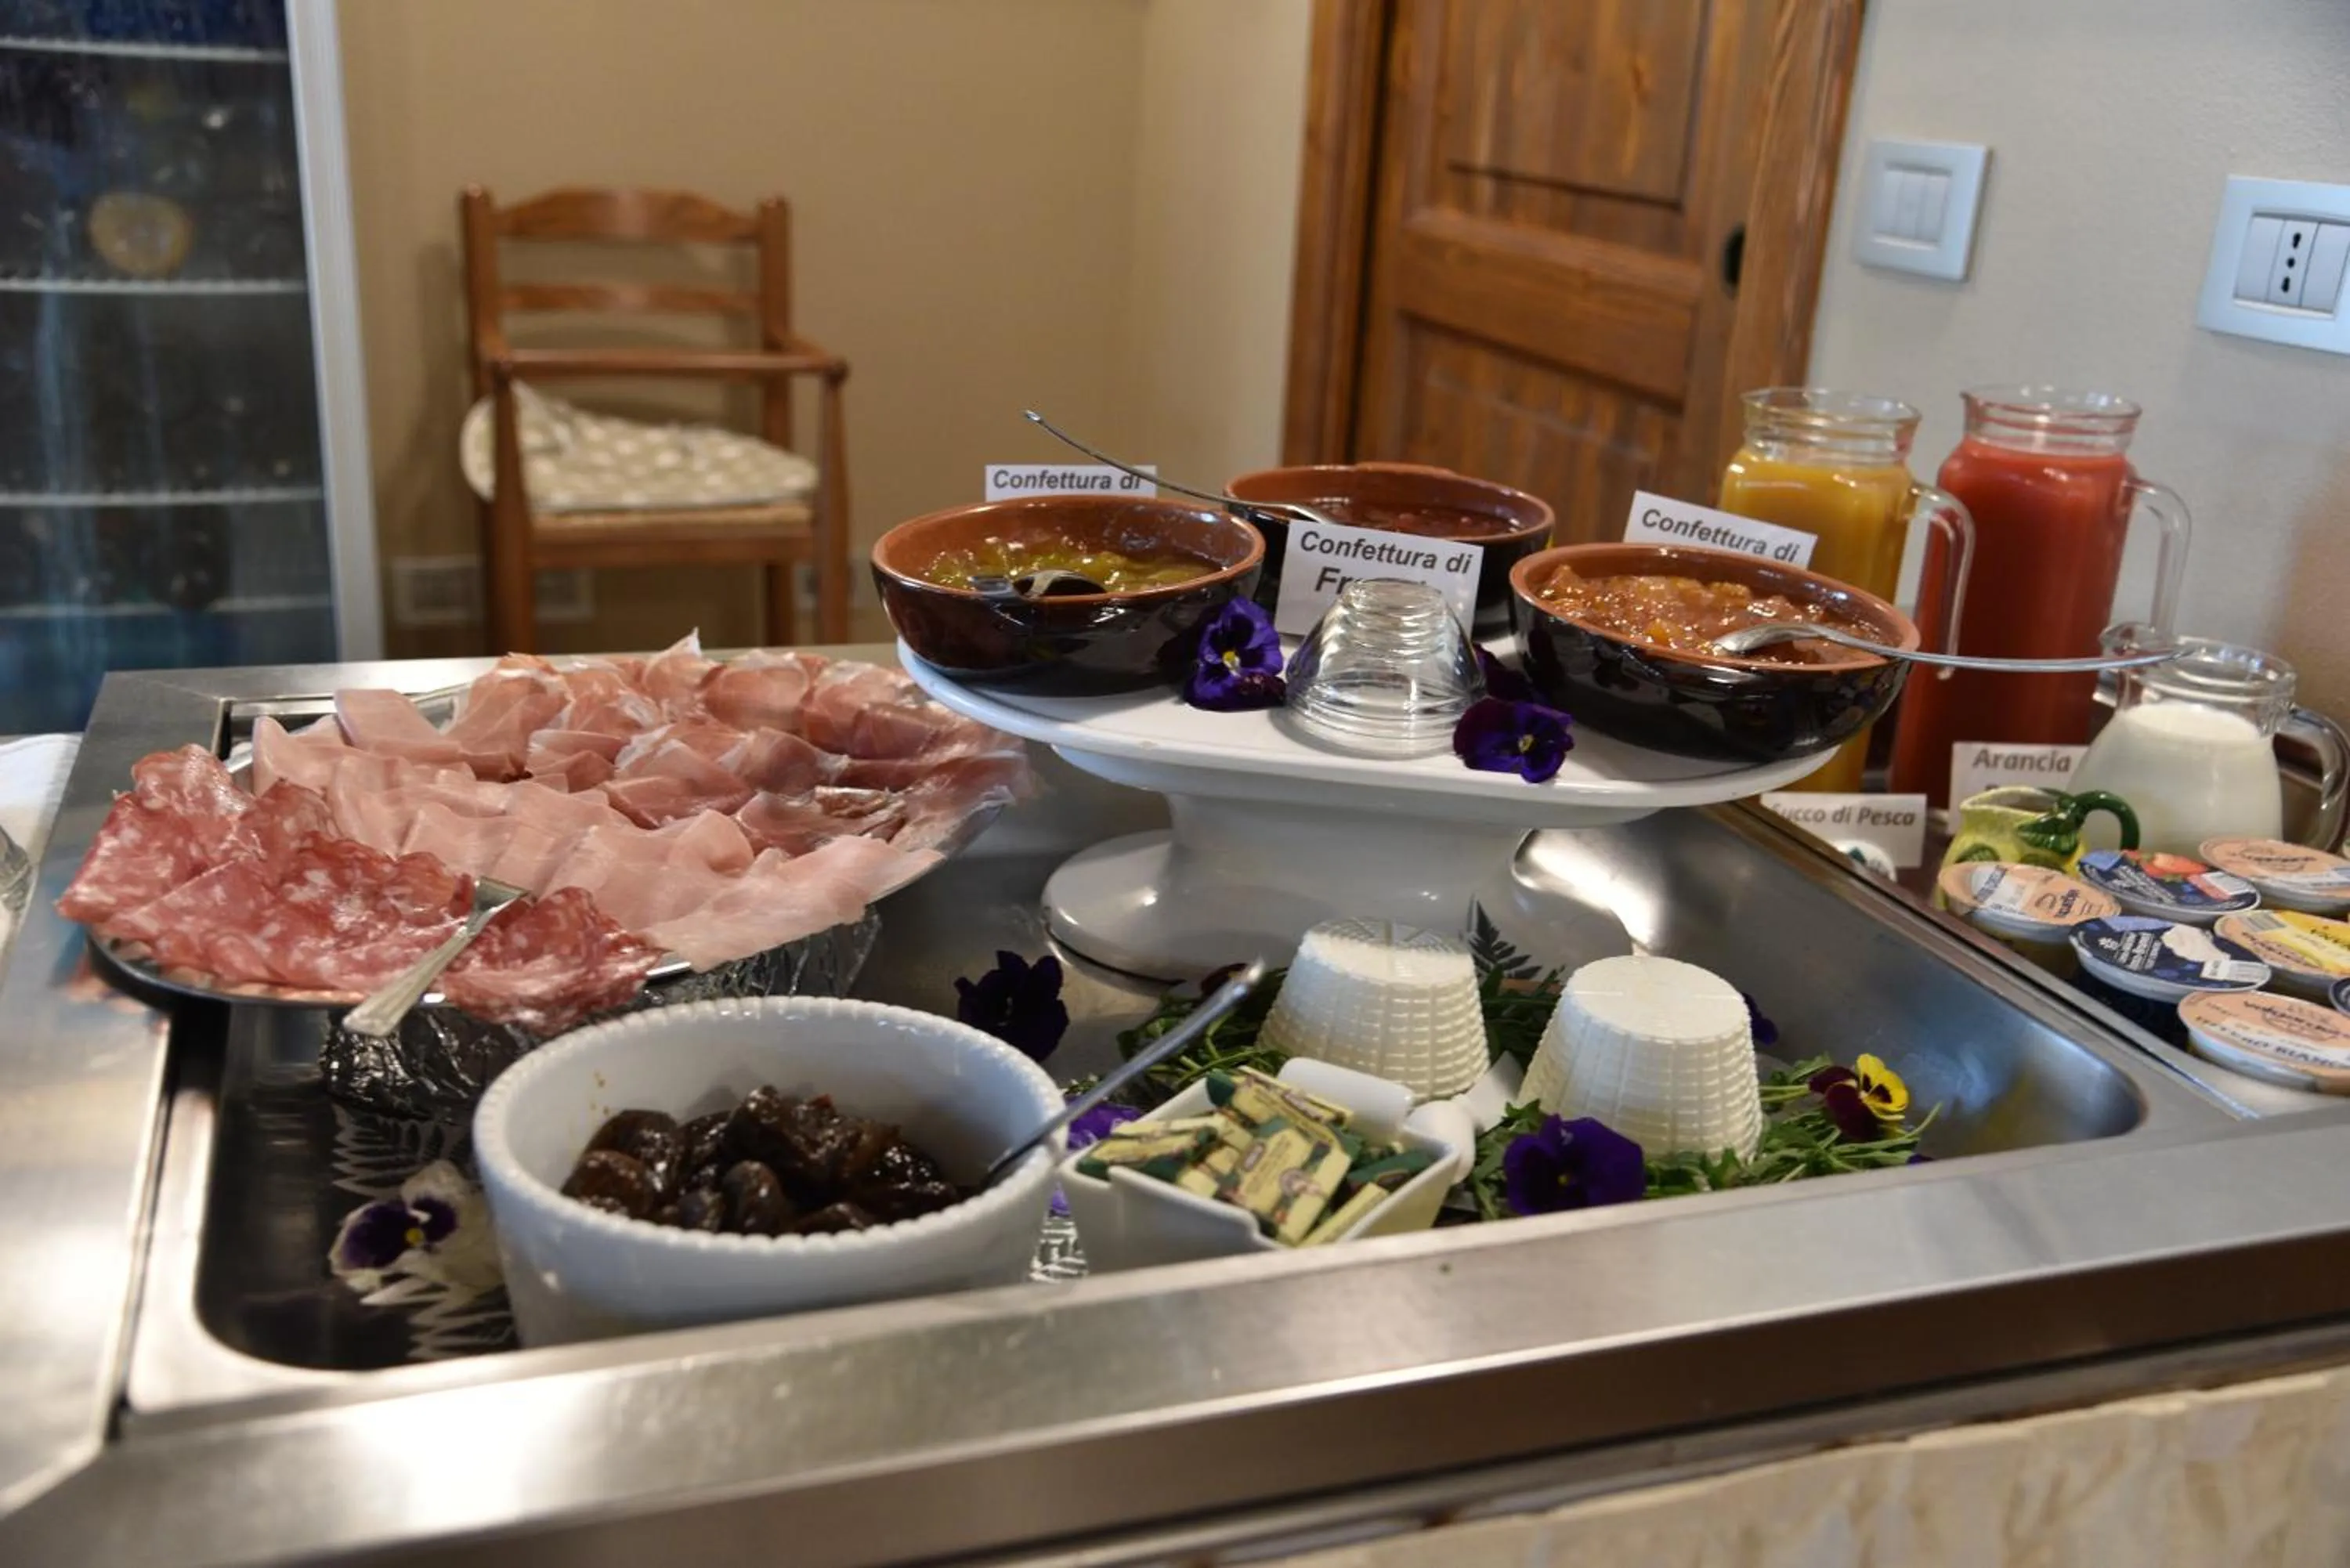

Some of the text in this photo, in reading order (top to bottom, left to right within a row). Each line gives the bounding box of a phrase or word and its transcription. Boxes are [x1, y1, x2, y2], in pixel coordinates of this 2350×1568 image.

[992, 469, 1141, 490] Confettura di
[1641, 508, 1801, 563] Confettura di
[1300, 530, 1473, 574] Confettura di
[1972, 748, 2072, 772] Arancia
[1831, 805, 1853, 825] di
[1857, 806, 1916, 826] Pesca
